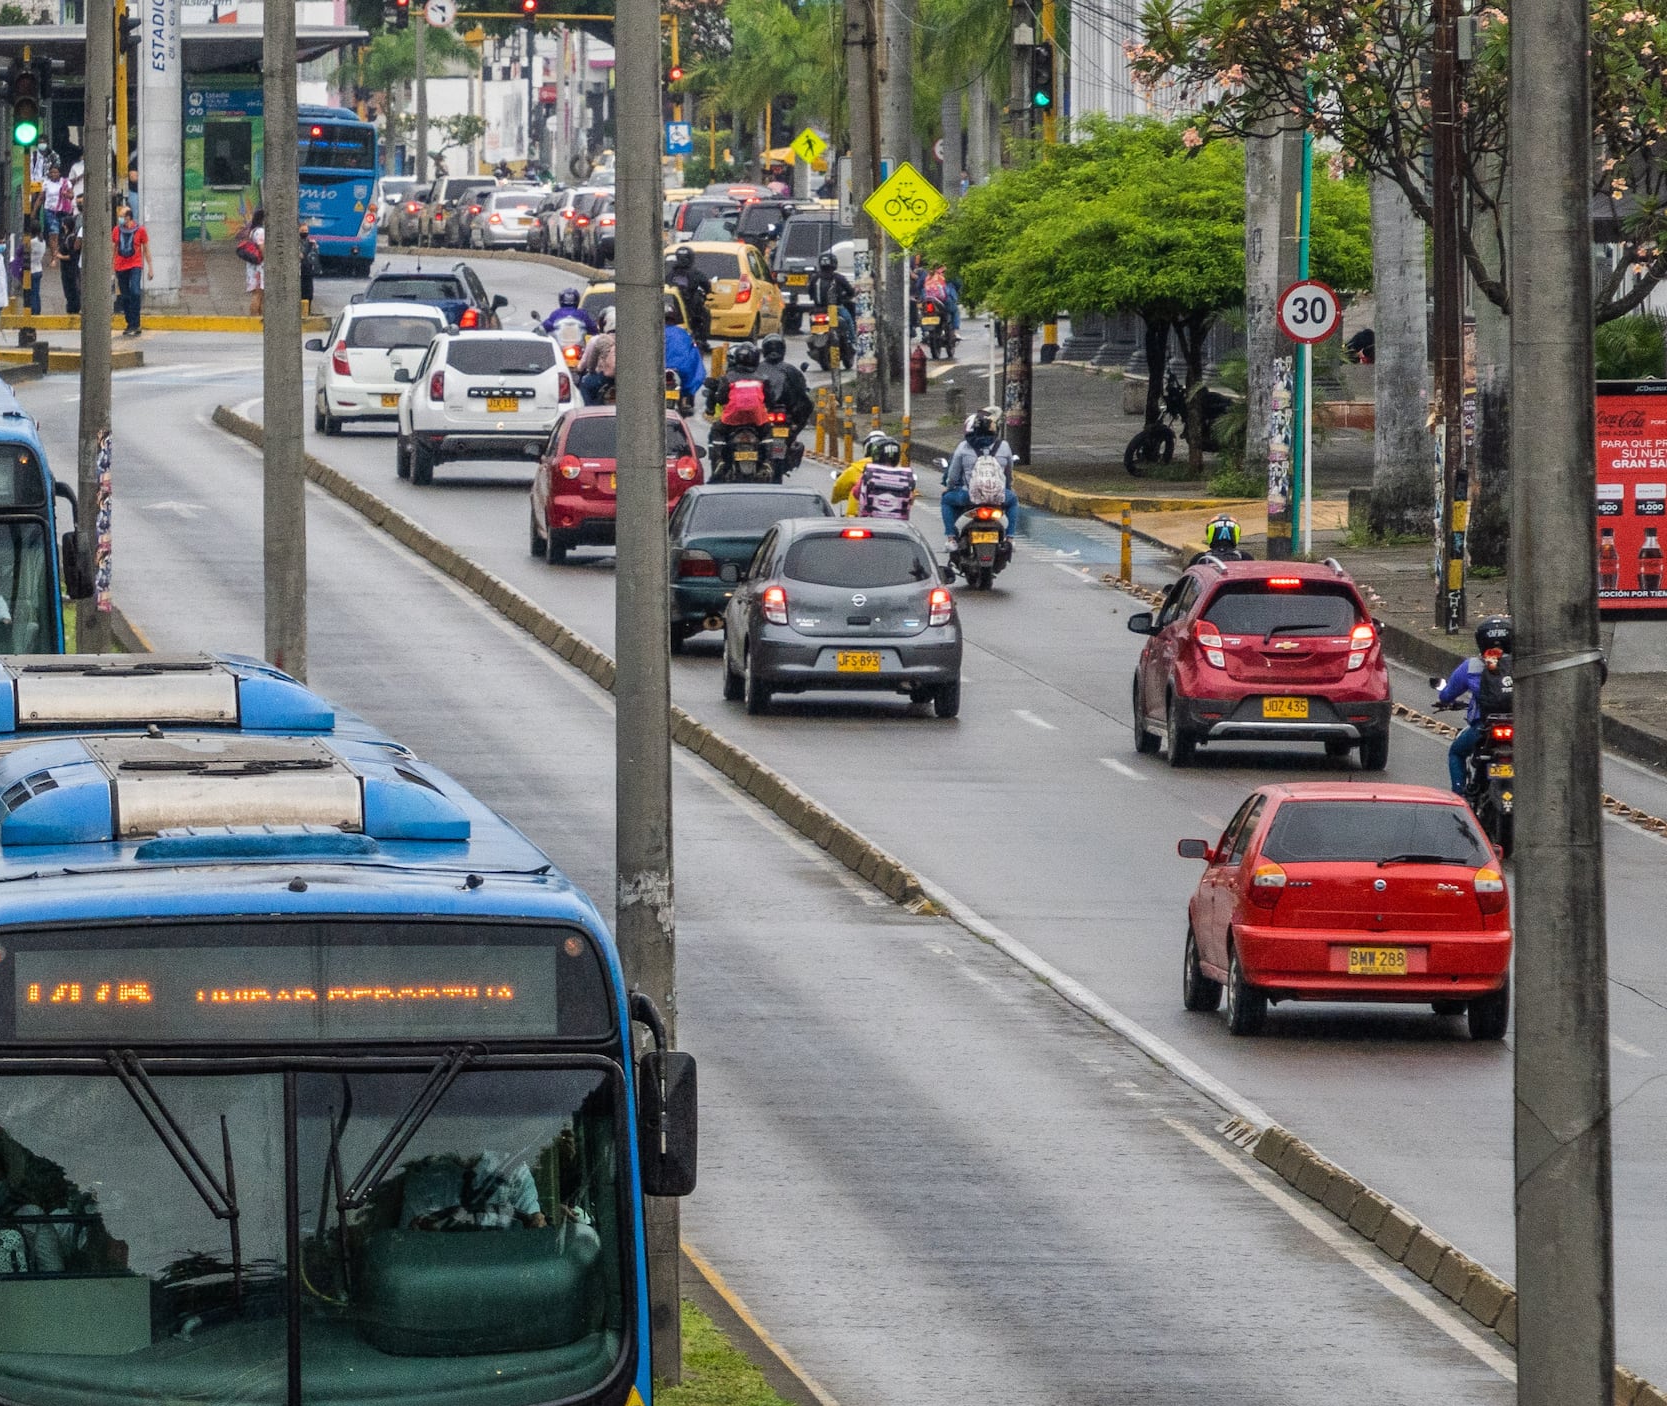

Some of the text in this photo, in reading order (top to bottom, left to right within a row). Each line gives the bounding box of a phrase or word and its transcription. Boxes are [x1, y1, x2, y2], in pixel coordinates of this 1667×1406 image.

[1292, 296, 1328, 325] 30
[1601, 440, 1629, 448] PARA
[1631, 440, 1653, 448] QUE
[1622, 449, 1638, 458] SU
[1612, 459, 1647, 468] GRAN
